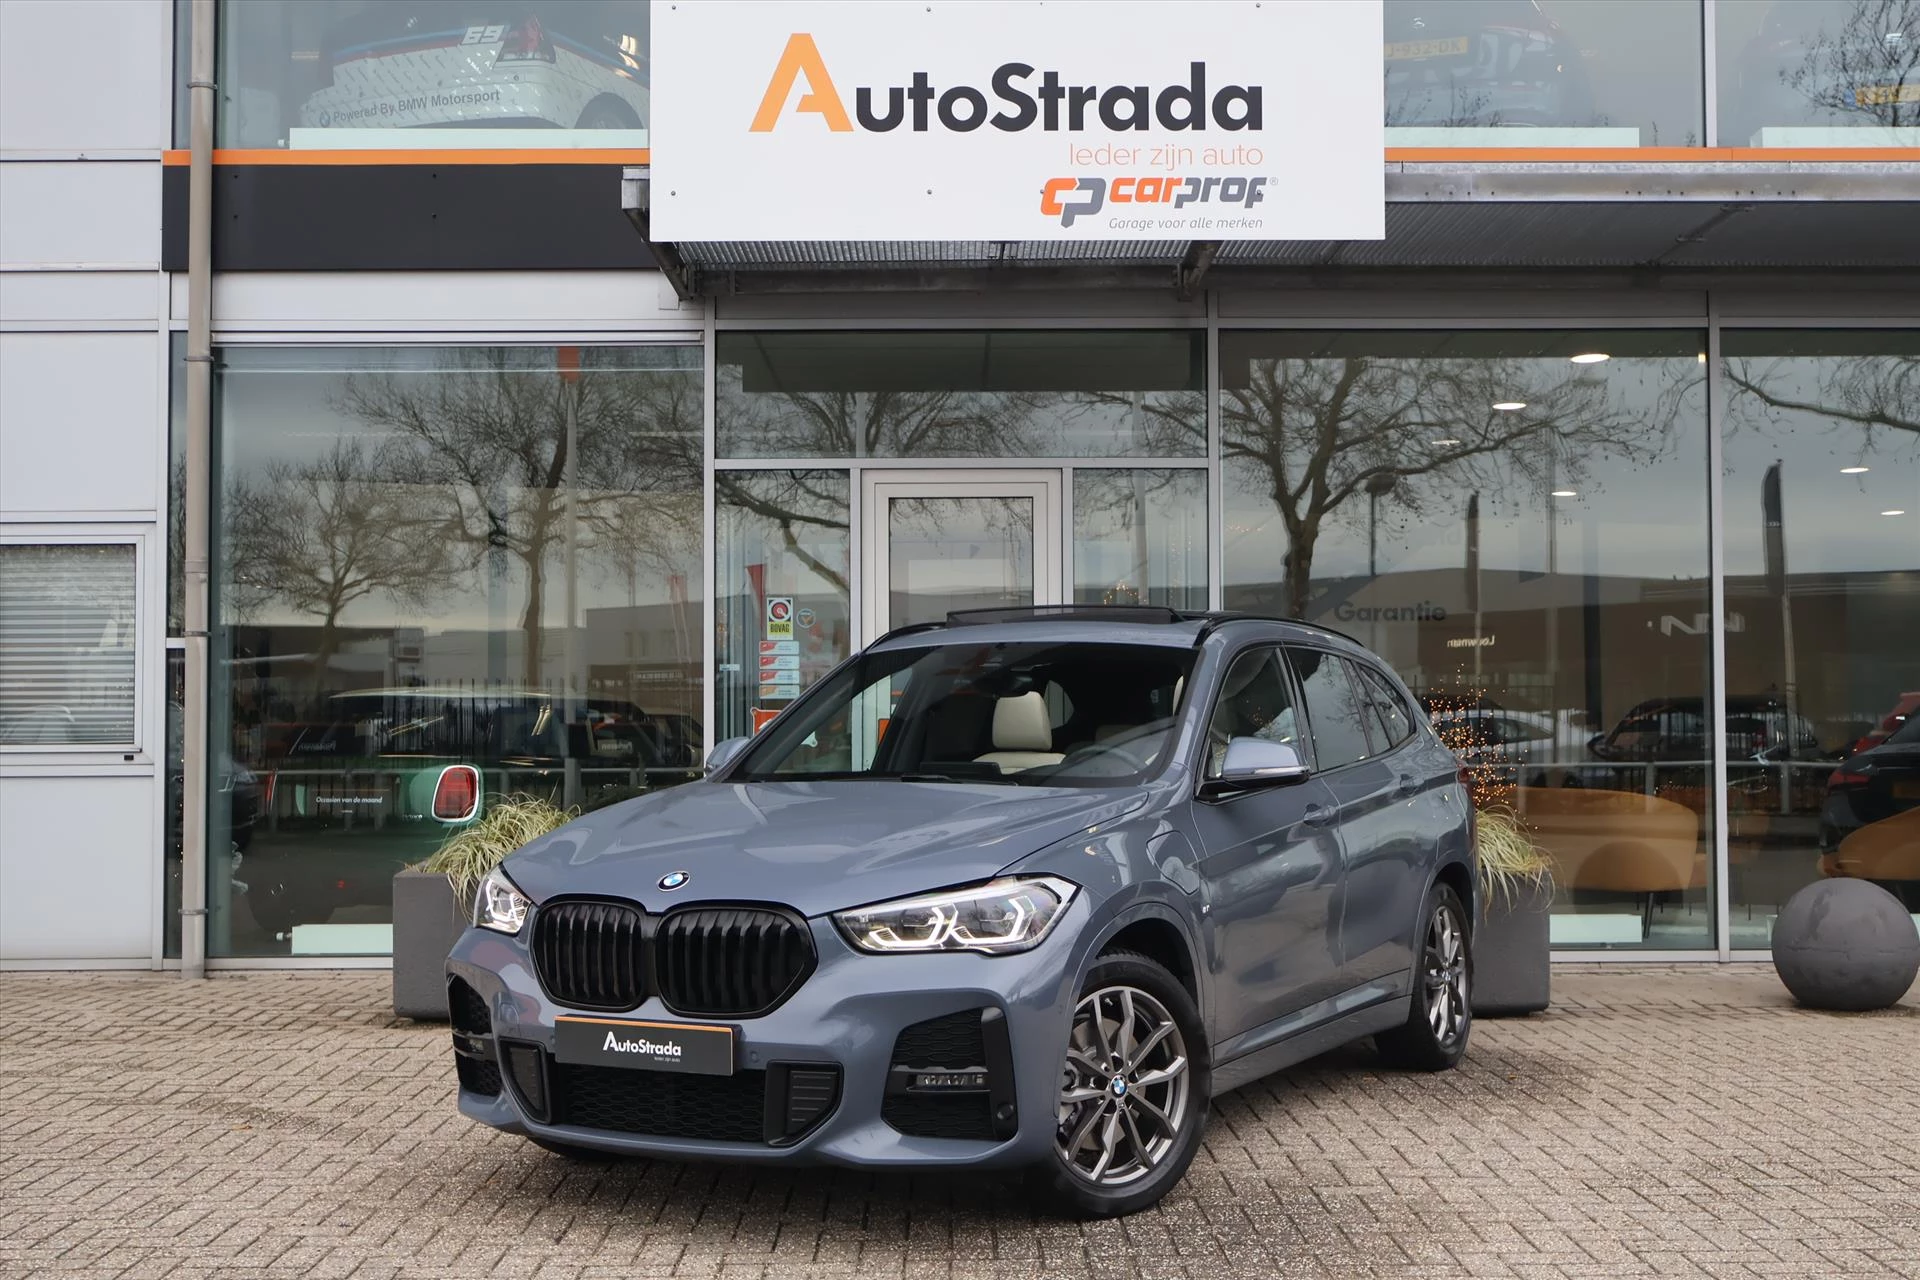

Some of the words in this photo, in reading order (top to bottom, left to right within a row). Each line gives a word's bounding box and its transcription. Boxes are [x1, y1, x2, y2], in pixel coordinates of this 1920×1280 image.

[461, 25, 505, 45] 69
[748, 33, 1263, 133] AutoStrada
[333, 104, 378, 122] Powered
[380, 102, 396, 116] By
[399, 98, 428, 112] BMW
[431, 89, 501, 108] Motorsport
[1070, 143, 1142, 166] Ieder
[1149, 143, 1194, 172] zijn
[1202, 145, 1264, 166] auto
[1109, 217, 1154, 232] Garage
[1158, 219, 1186, 229] voor
[1189, 217, 1213, 229] alle
[1216, 217, 1264, 229] merken
[1334, 601, 1447, 622] Garantie
[770, 623, 790, 633] BOVAG
[603, 1031, 682, 1056] AutoStrada
